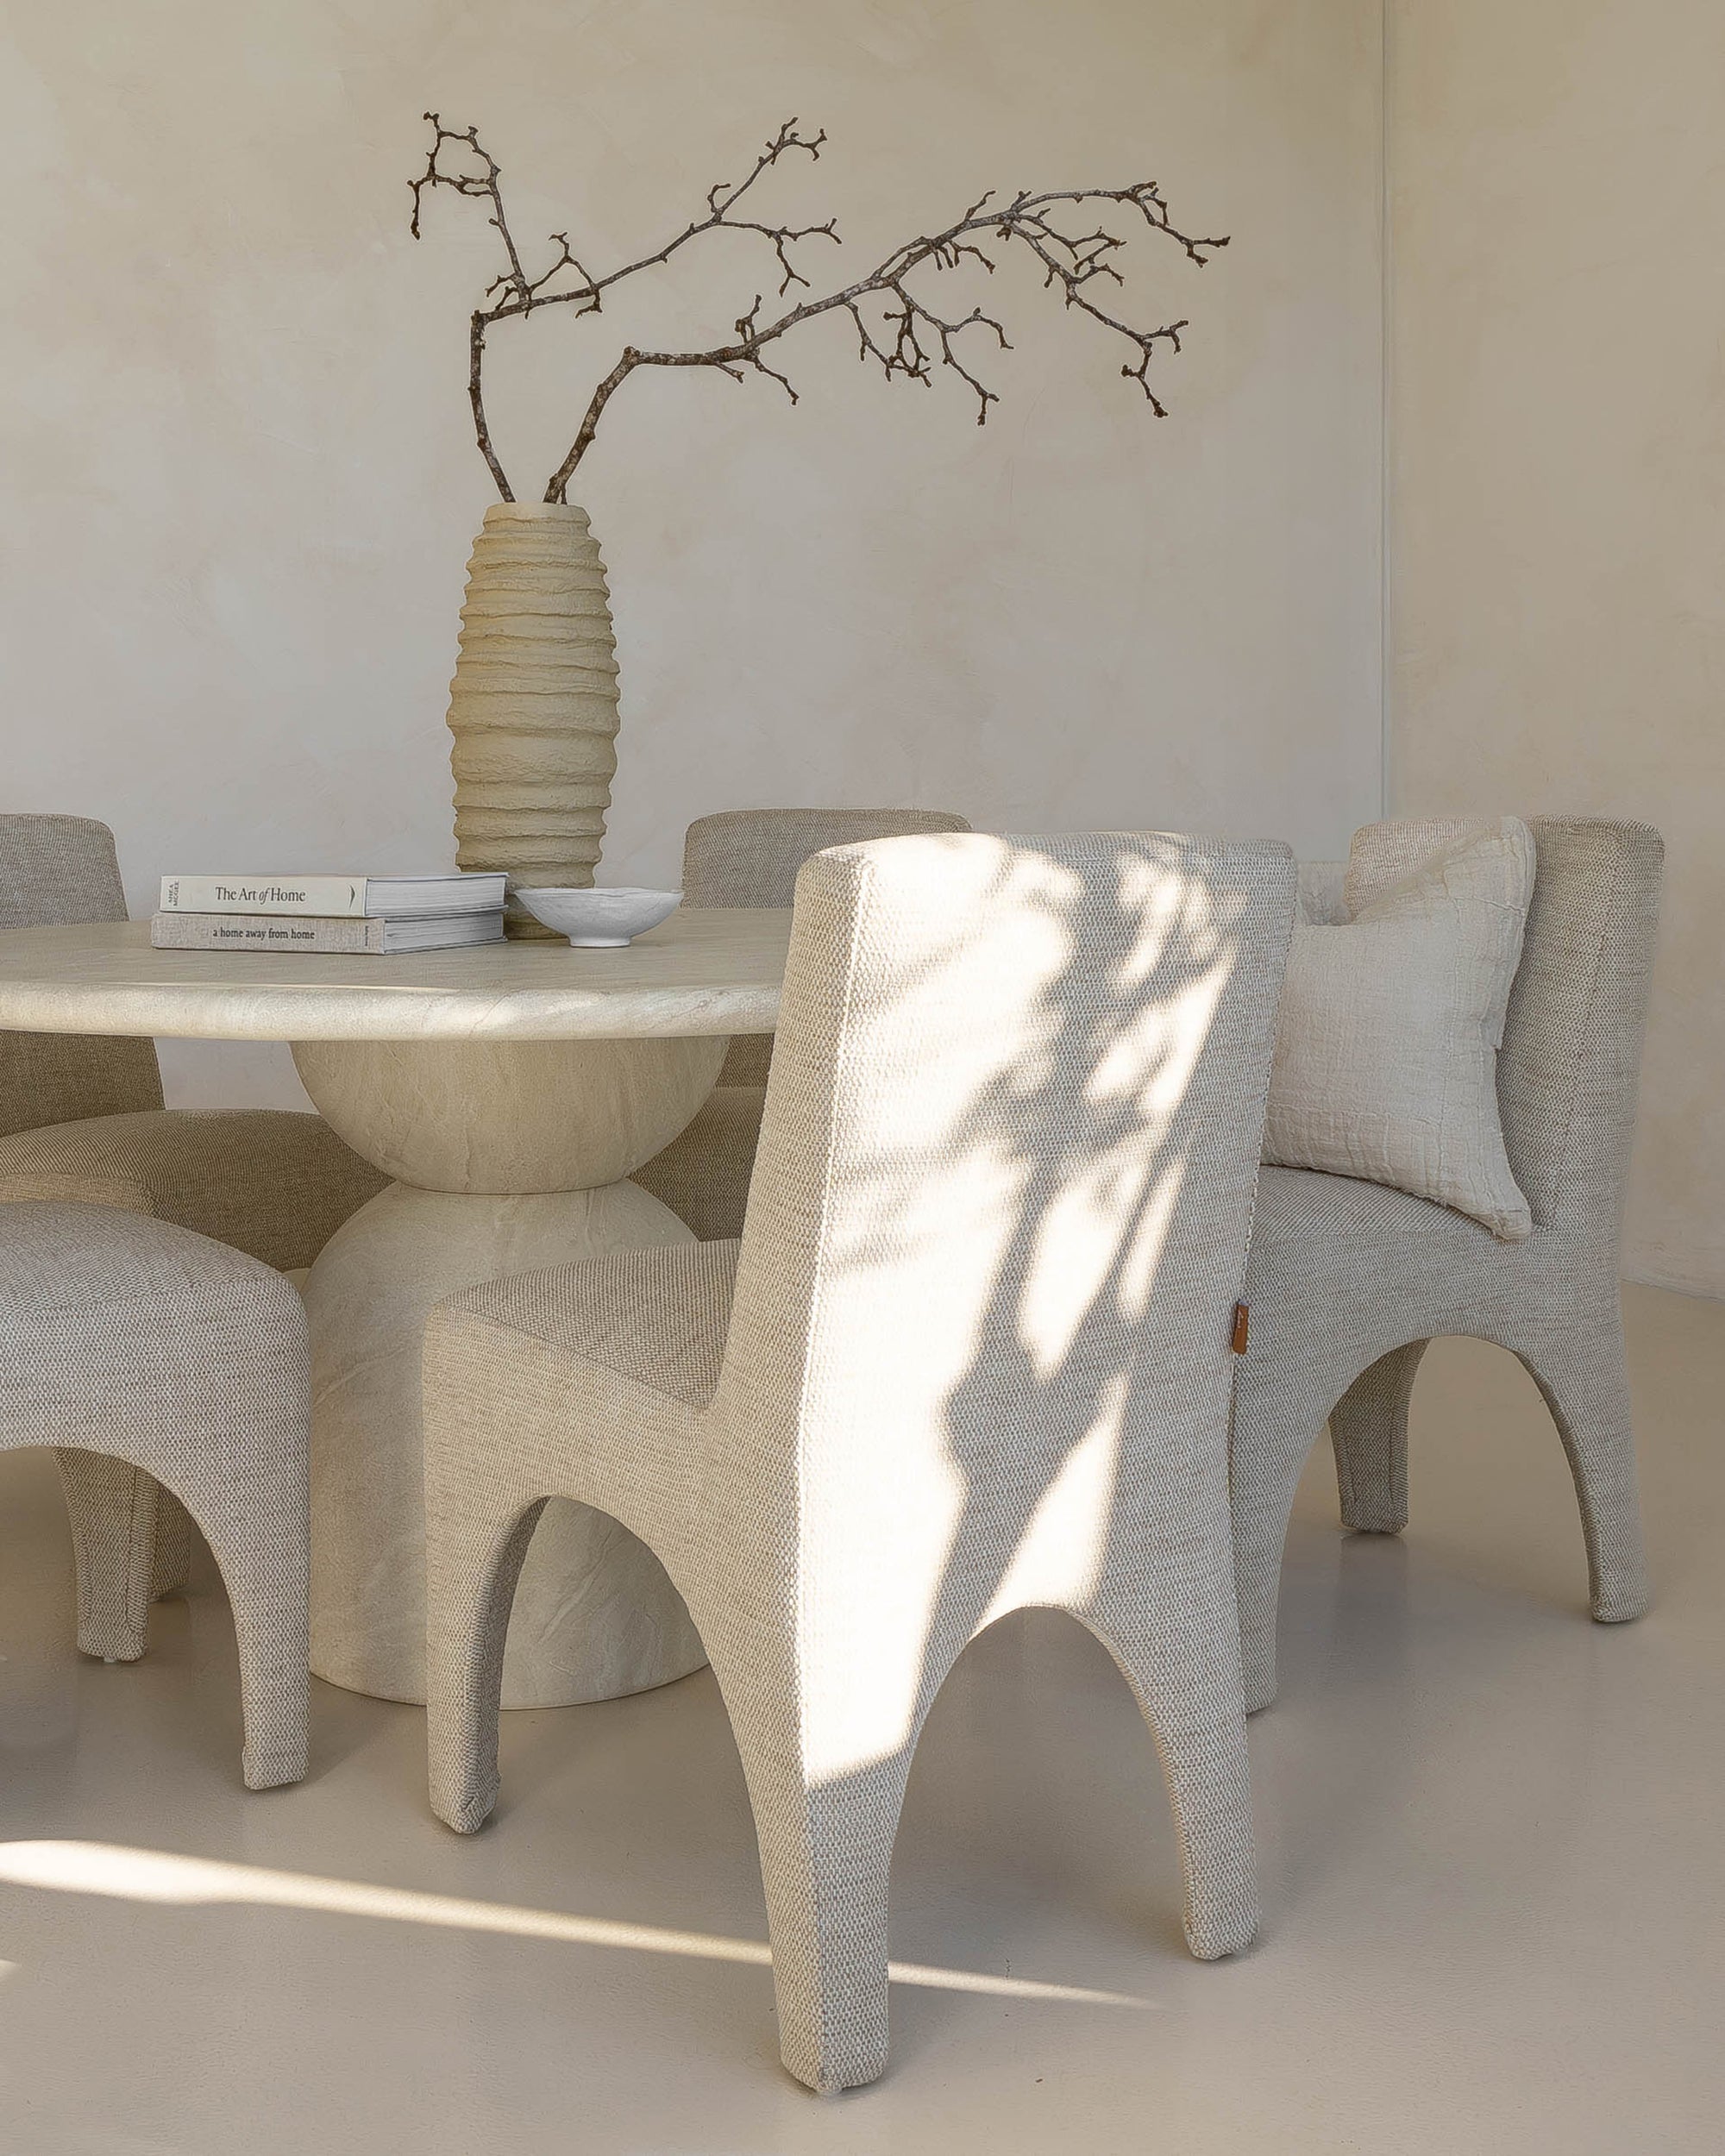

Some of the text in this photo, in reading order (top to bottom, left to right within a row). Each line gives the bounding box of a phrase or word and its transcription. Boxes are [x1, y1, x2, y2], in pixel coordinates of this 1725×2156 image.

[215, 887, 306, 905] The Art of Home
[213, 926, 316, 941] a home away from home
